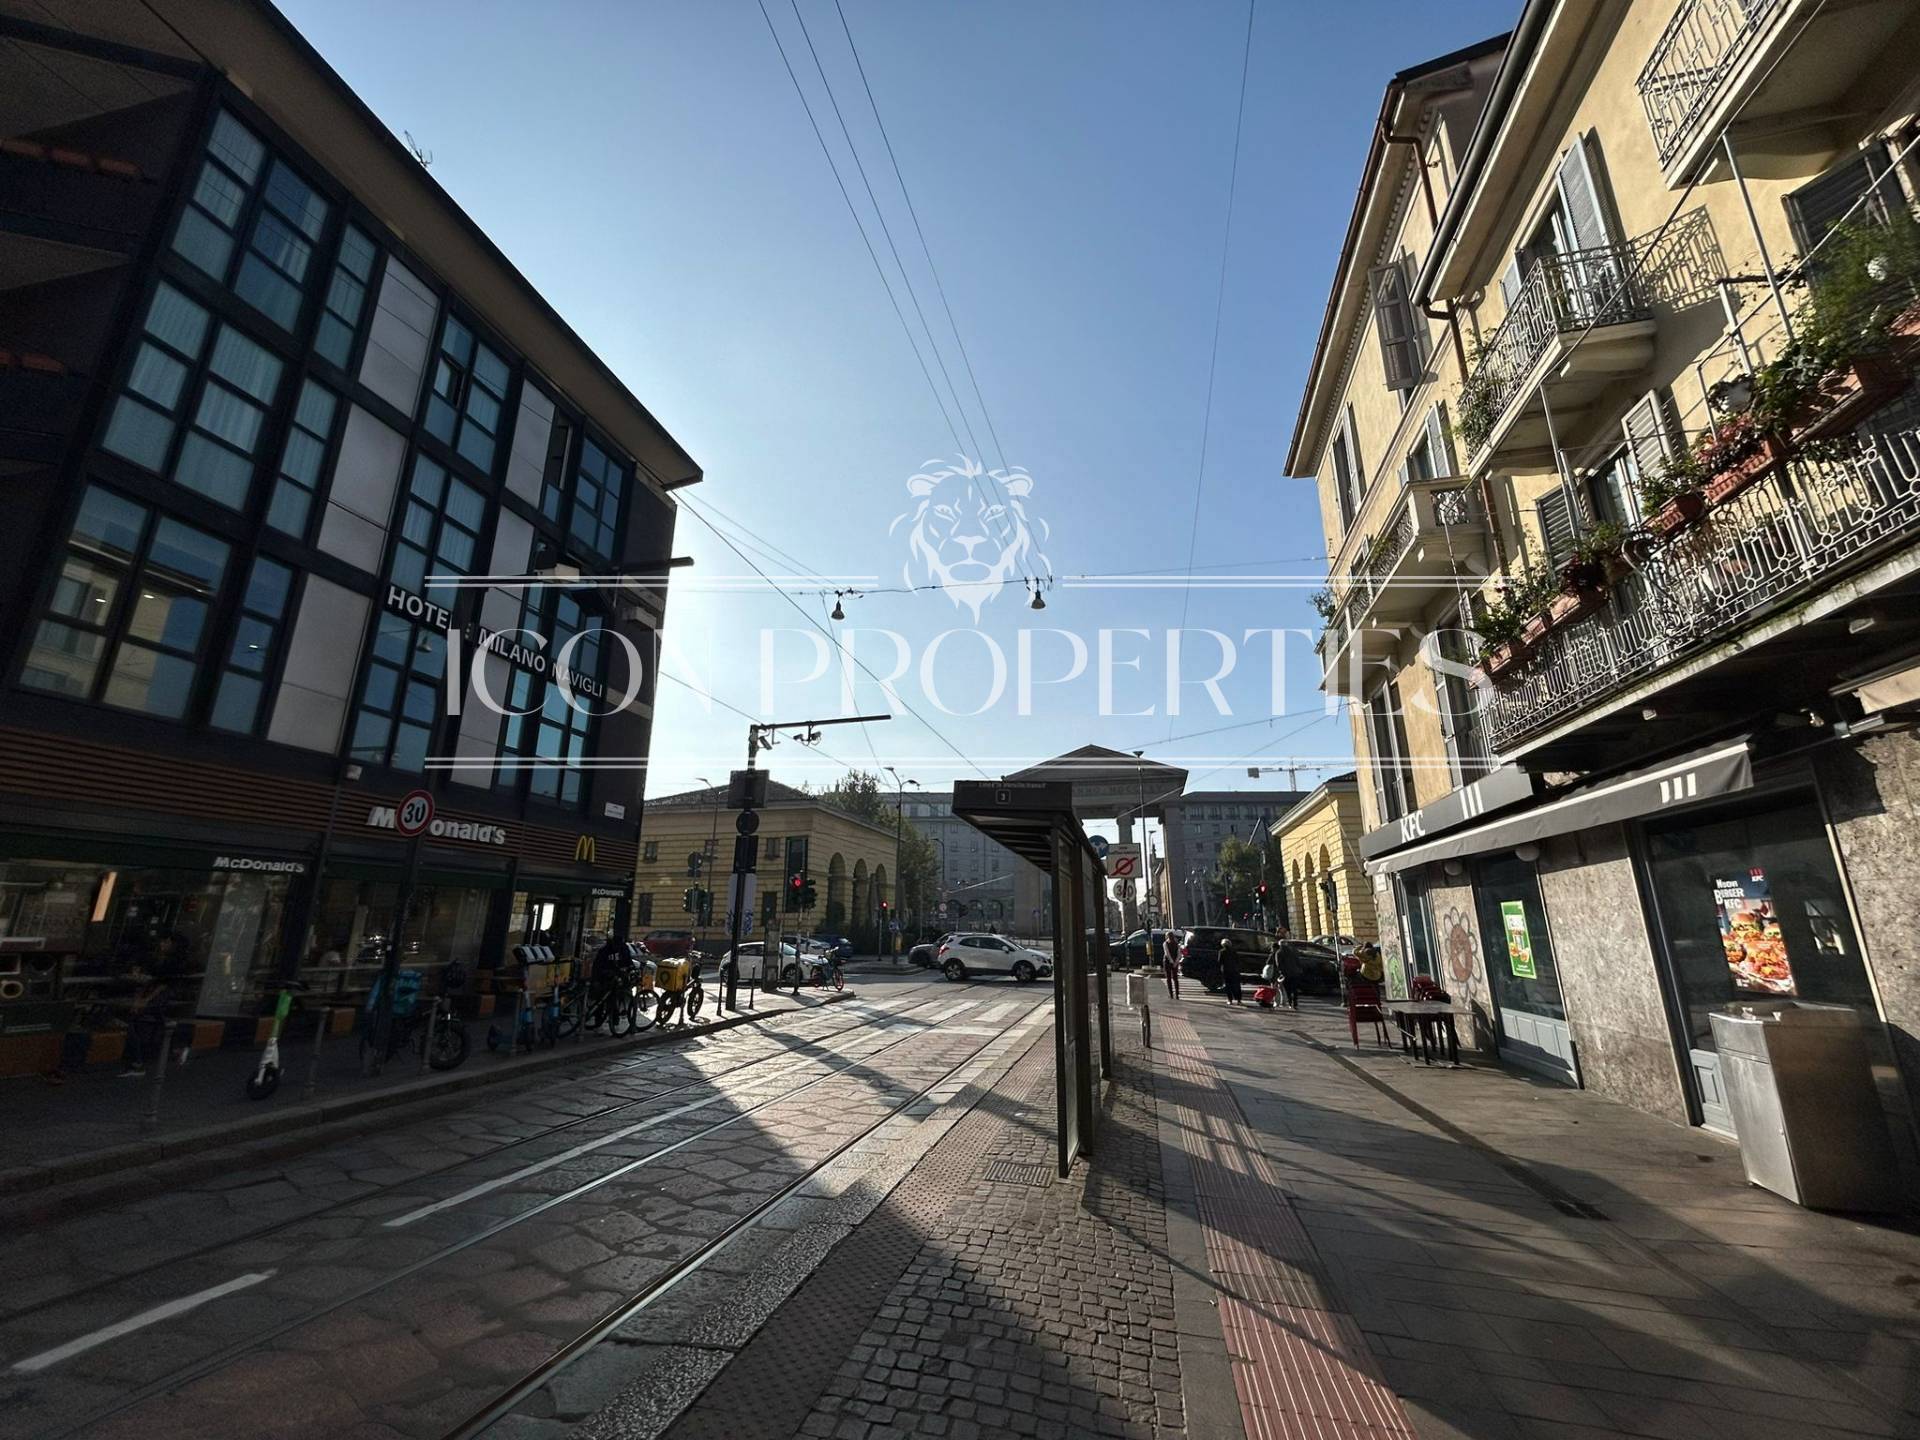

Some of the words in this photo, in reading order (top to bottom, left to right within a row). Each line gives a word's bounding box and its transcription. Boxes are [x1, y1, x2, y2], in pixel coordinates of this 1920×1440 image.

[478, 628, 546, 672] MILANO
[551, 662, 603, 697] NAVIGLI
[366, 806, 506, 845] Monald's
[403, 802, 426, 824] 30
[1400, 809, 1426, 844] KFC
[213, 856, 305, 873] McDonald's
